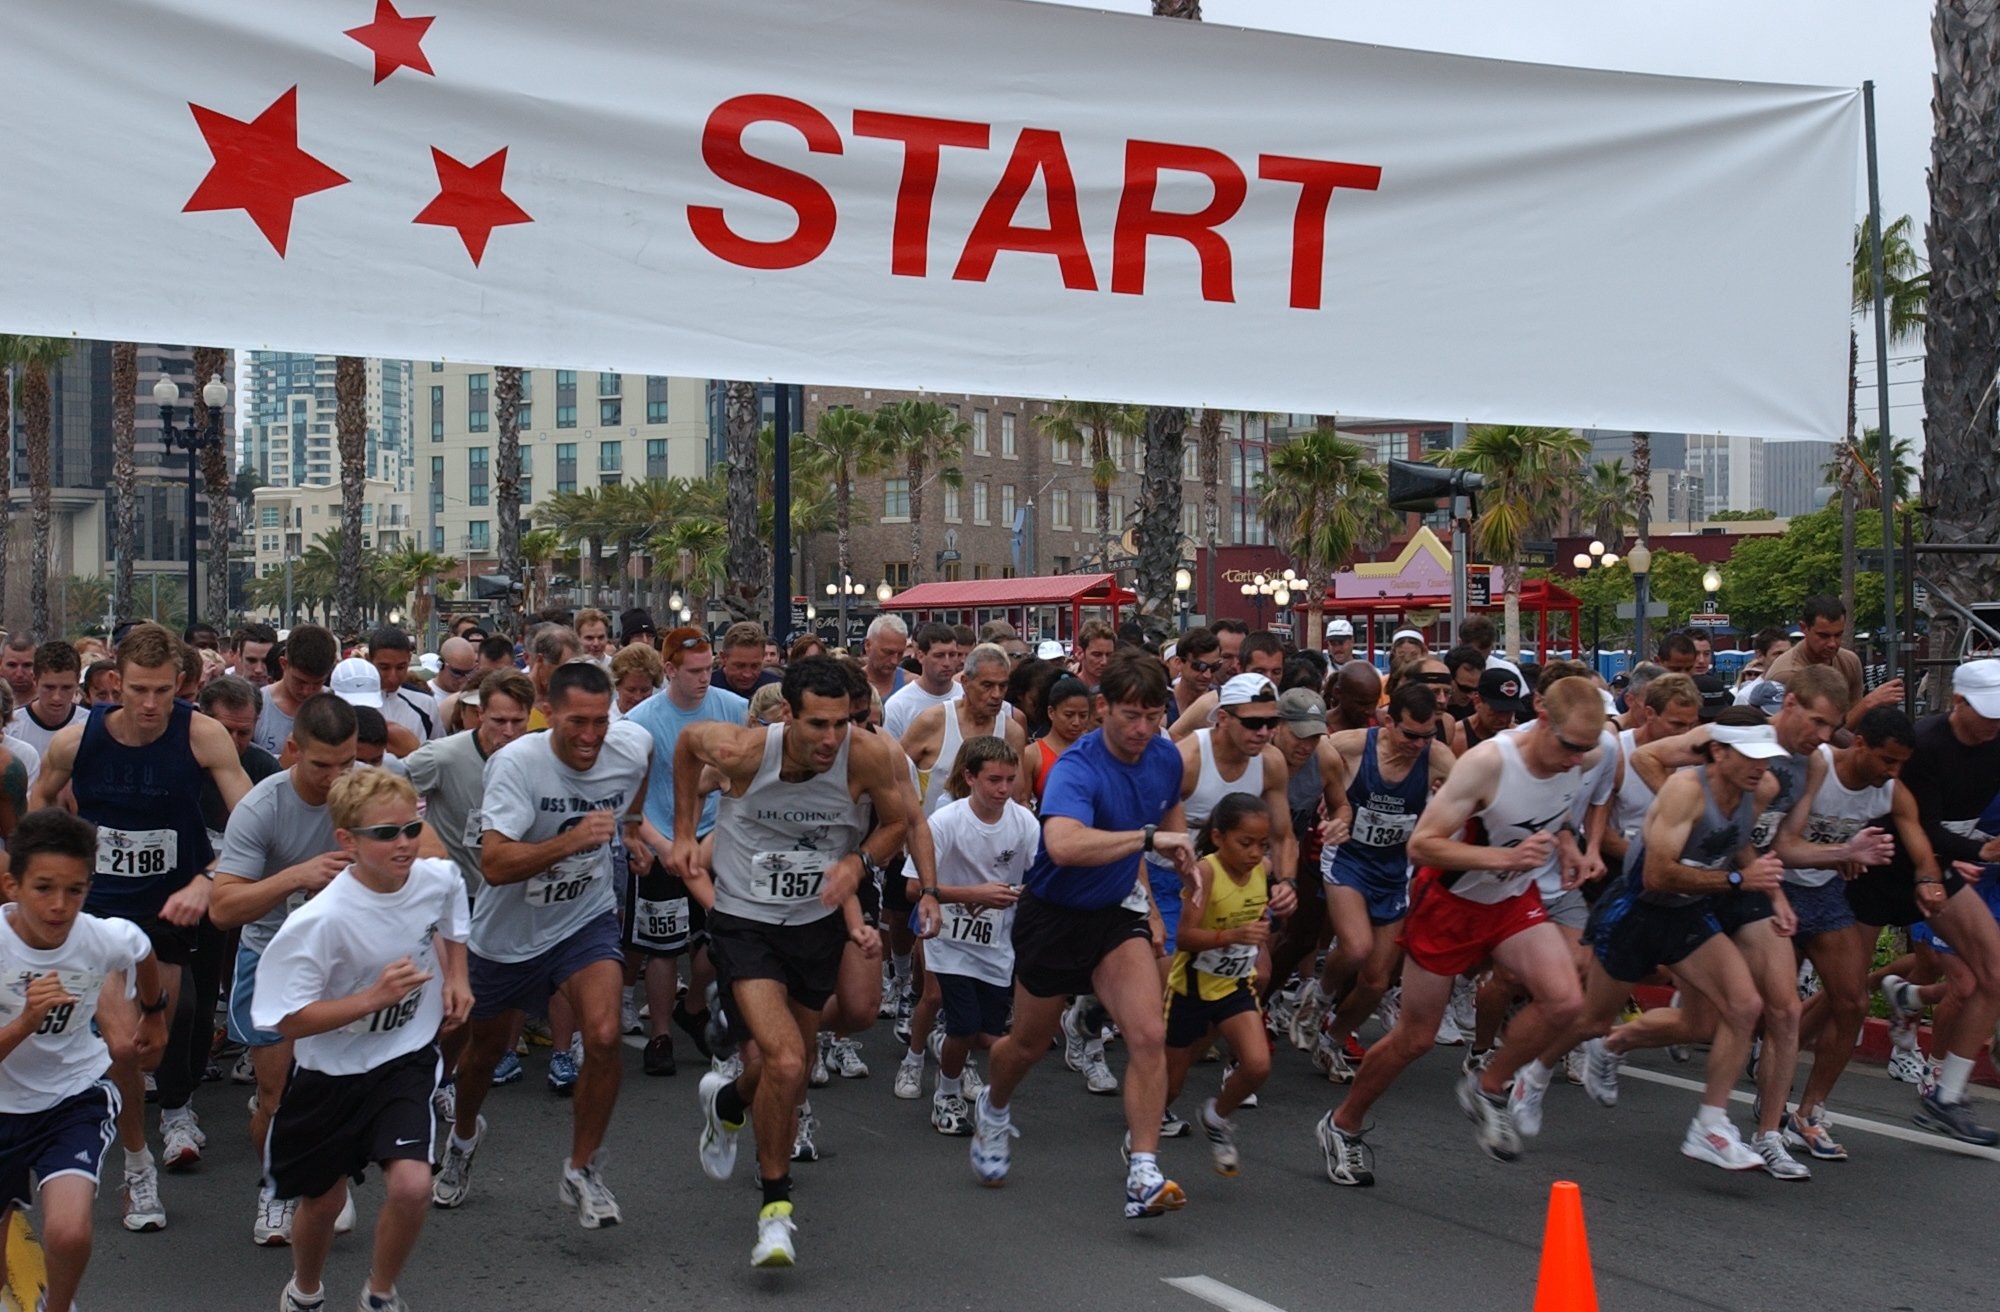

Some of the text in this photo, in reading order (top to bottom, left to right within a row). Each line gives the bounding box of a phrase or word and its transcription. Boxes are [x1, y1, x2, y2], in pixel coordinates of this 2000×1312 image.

[686, 93, 1383, 310] START
[541, 796, 566, 813] USS
[783, 811, 825, 822] COHN
[1366, 825, 1404, 845] 1334
[112, 849, 164, 874] 2198
[544, 875, 593, 904] 1207
[769, 871, 825, 898] 1357
[649, 915, 676, 935] 955
[952, 917, 993, 944] 1746
[1213, 956, 1249, 976] 257
